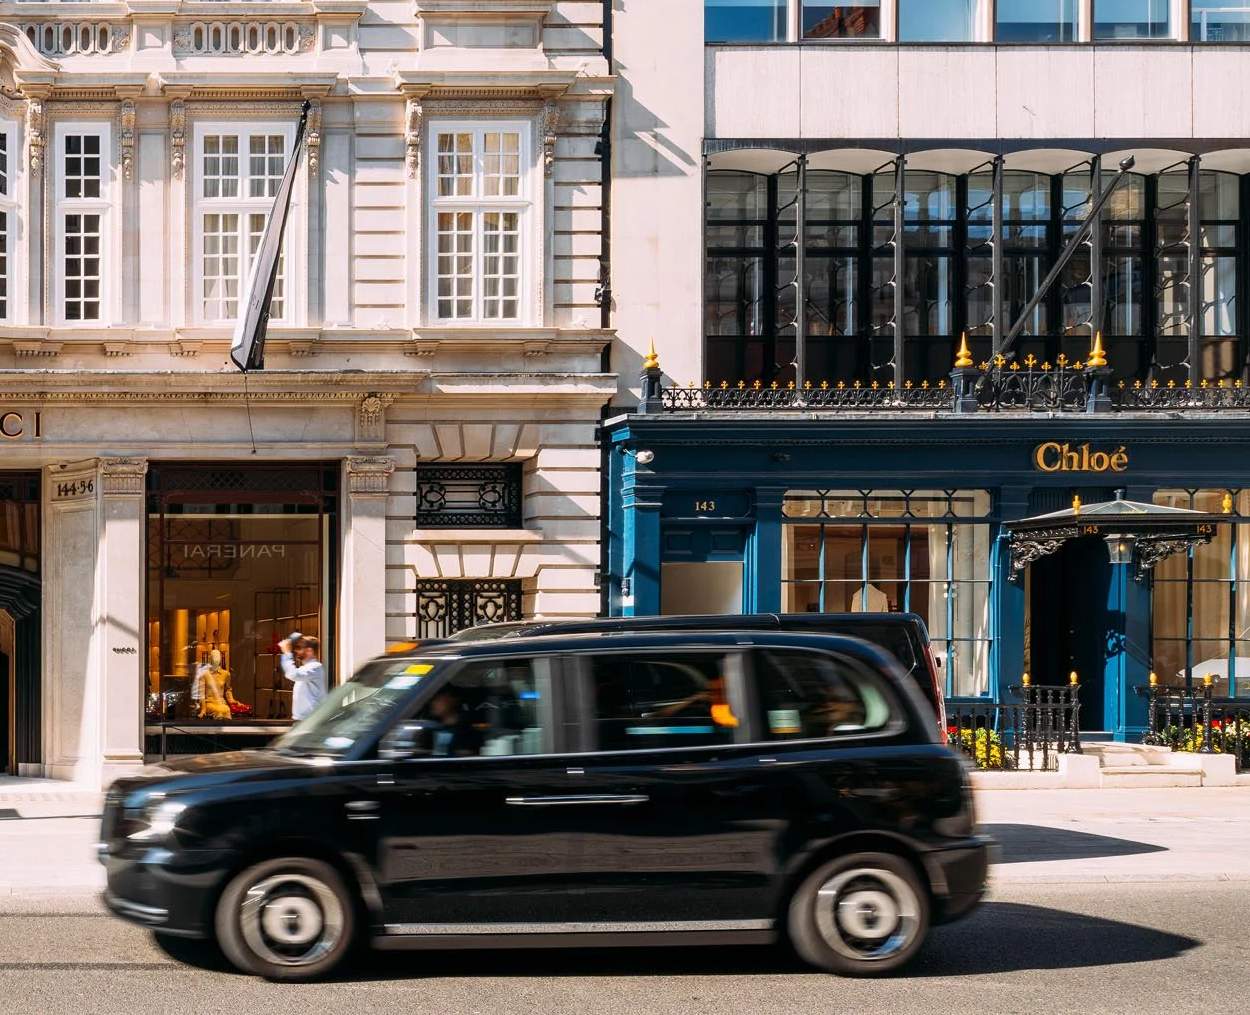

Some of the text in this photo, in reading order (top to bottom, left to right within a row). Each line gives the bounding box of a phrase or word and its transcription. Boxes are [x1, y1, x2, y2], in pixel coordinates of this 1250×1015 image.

[1035, 442, 1128, 472] Chloé
[695, 501, 715, 511] 143
[1083, 525, 1099, 534] 143
[1196, 524, 1212, 533] 143
